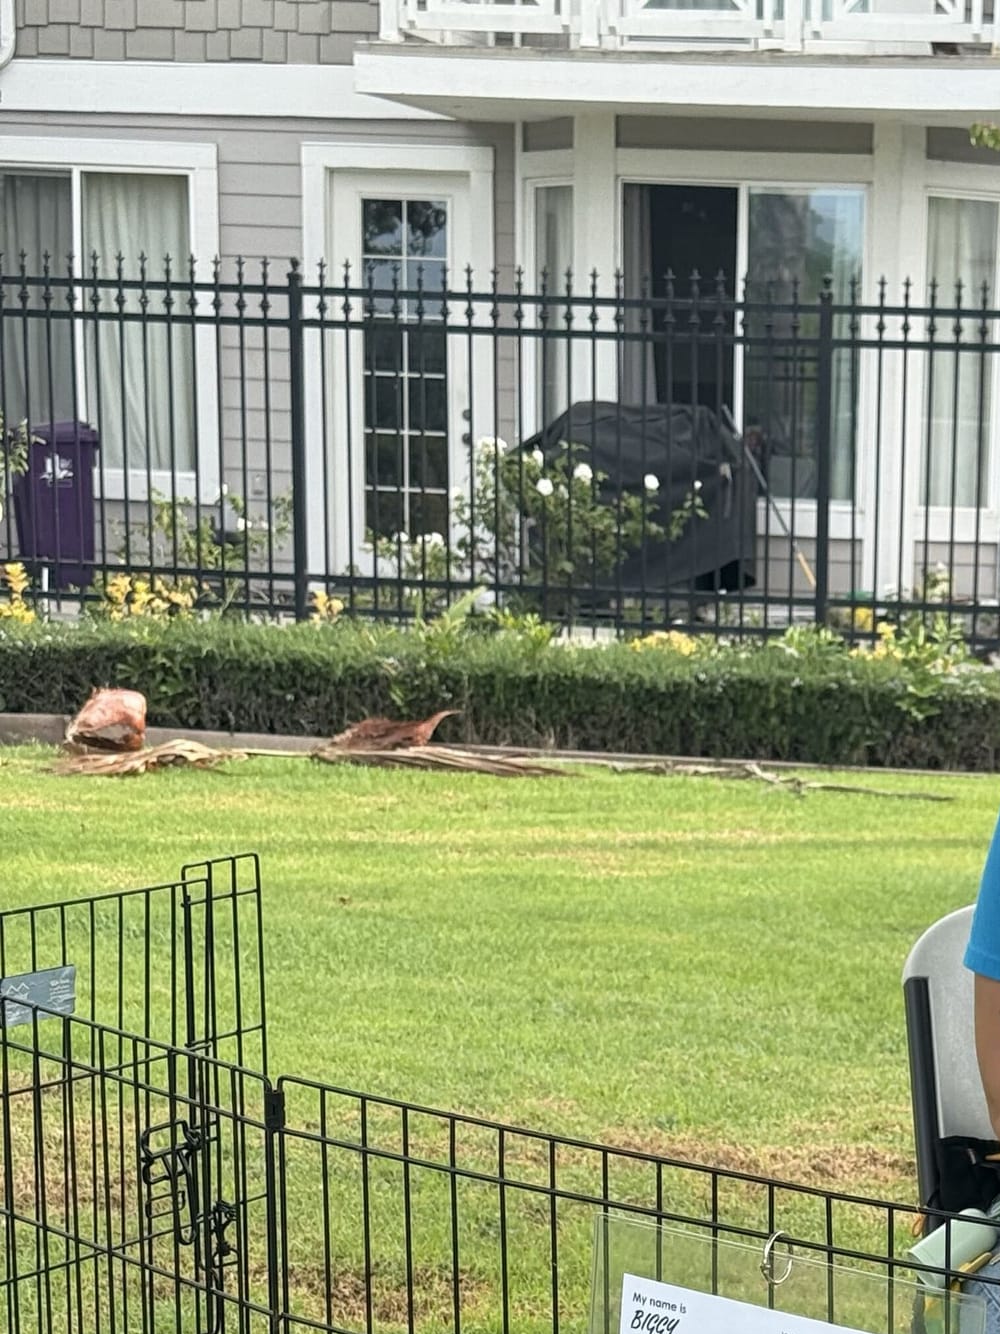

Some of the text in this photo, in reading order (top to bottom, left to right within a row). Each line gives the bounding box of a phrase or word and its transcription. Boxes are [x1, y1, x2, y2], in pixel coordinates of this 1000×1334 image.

[632, 1292, 687, 1314] My name is
